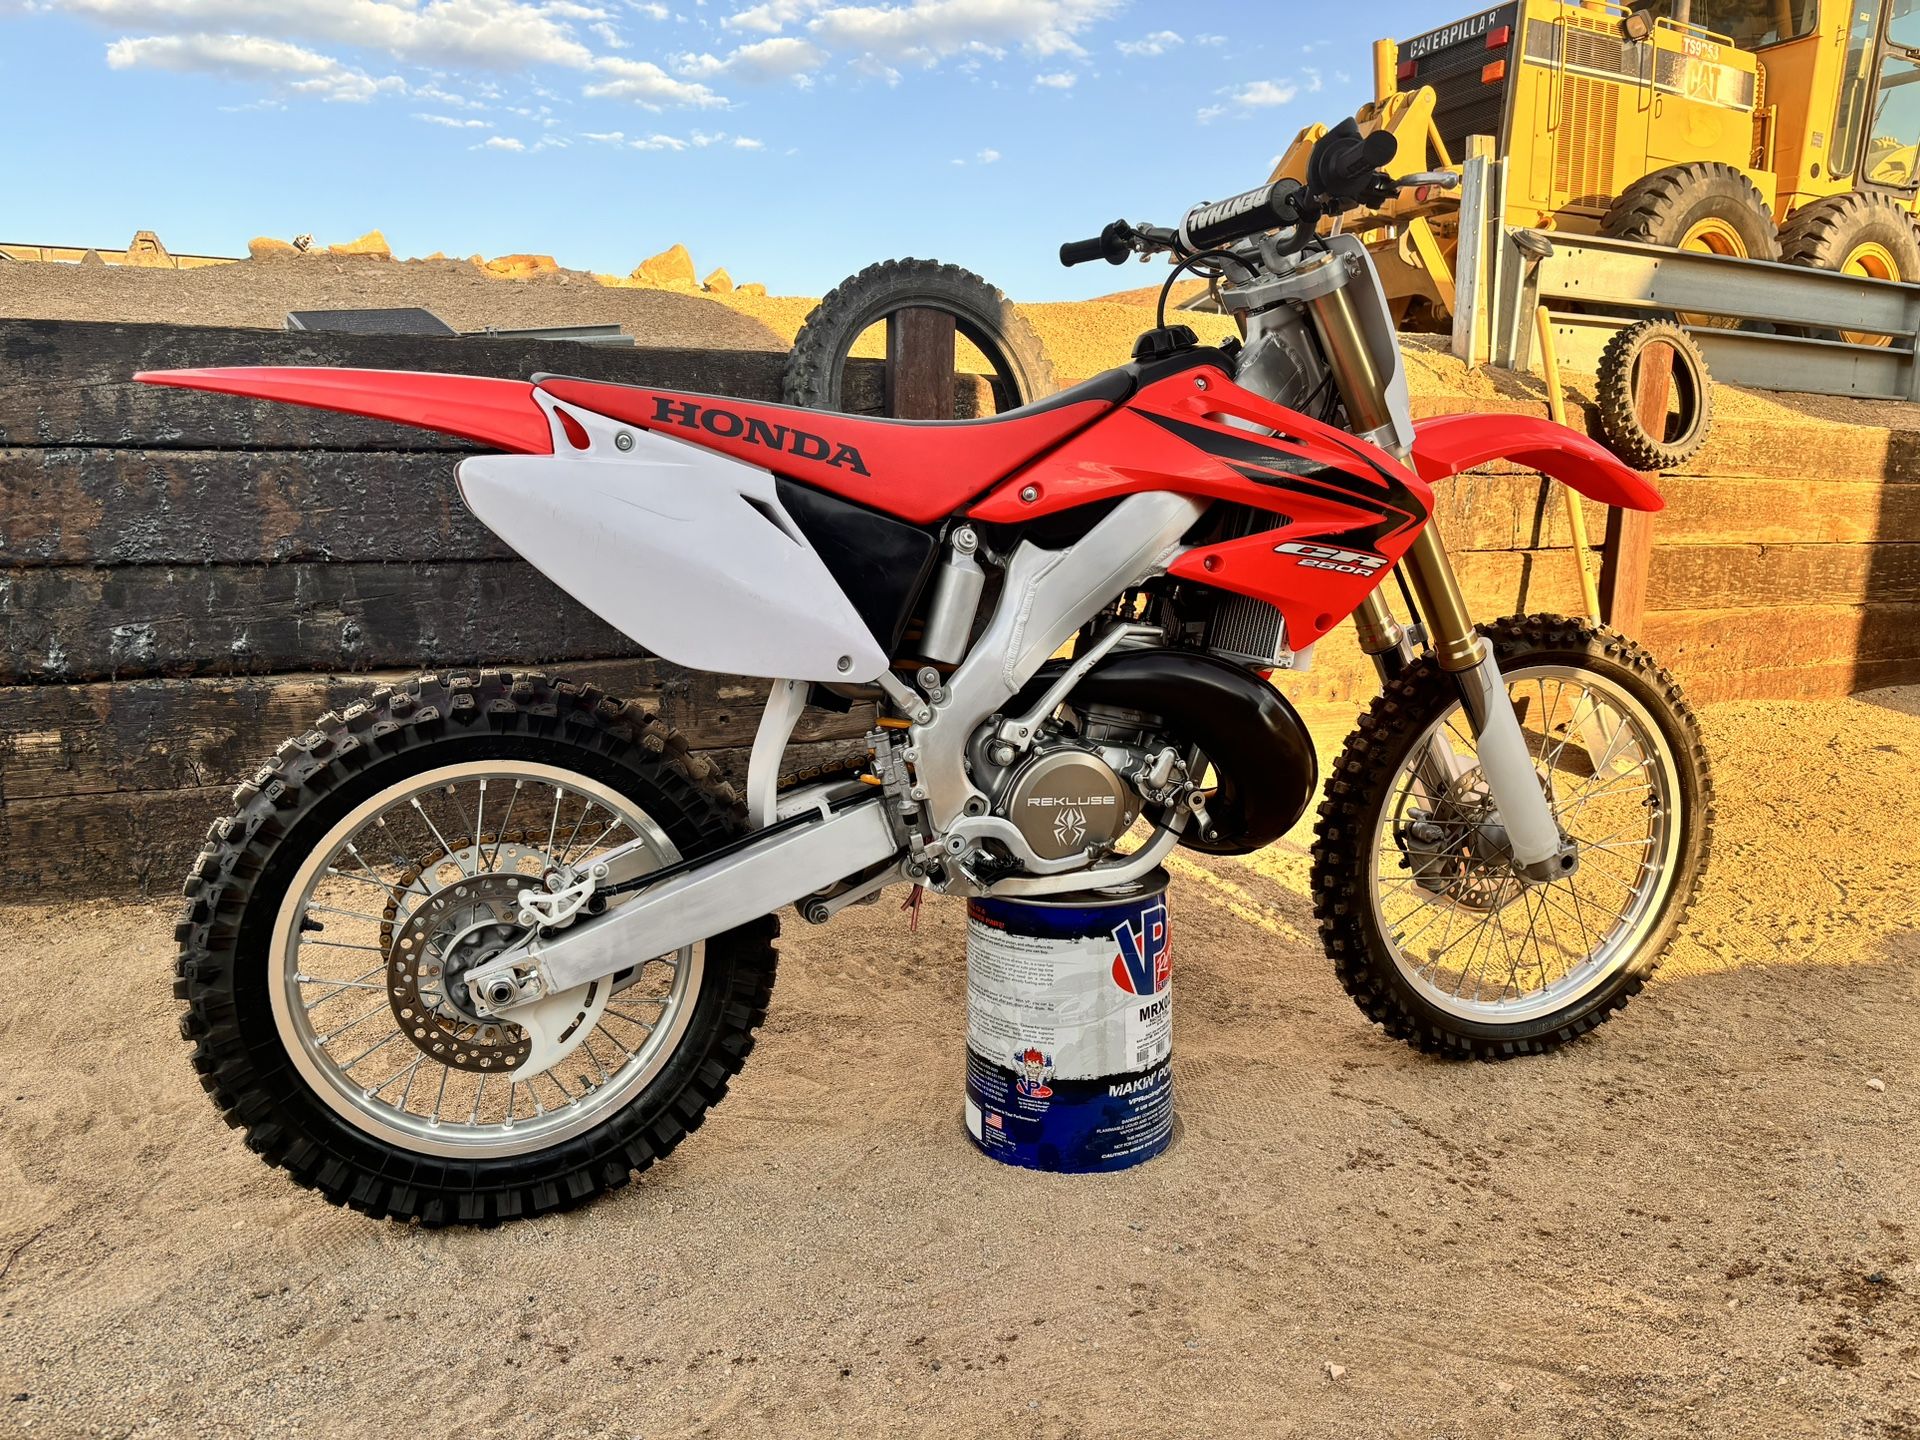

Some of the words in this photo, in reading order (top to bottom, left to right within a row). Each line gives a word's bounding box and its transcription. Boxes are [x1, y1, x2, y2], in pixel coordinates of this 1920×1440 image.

[1410, 11, 1497, 58] CATERPILLAR
[1686, 59, 1721, 101] CAT
[1189, 184, 1272, 232] RENTHAL
[651, 396, 871, 477] HONDA
[1273, 542, 1388, 569] CR
[1297, 558, 1375, 577] 250R
[1027, 796, 1116, 807] REKLUSE
[1112, 904, 1167, 996] VP
